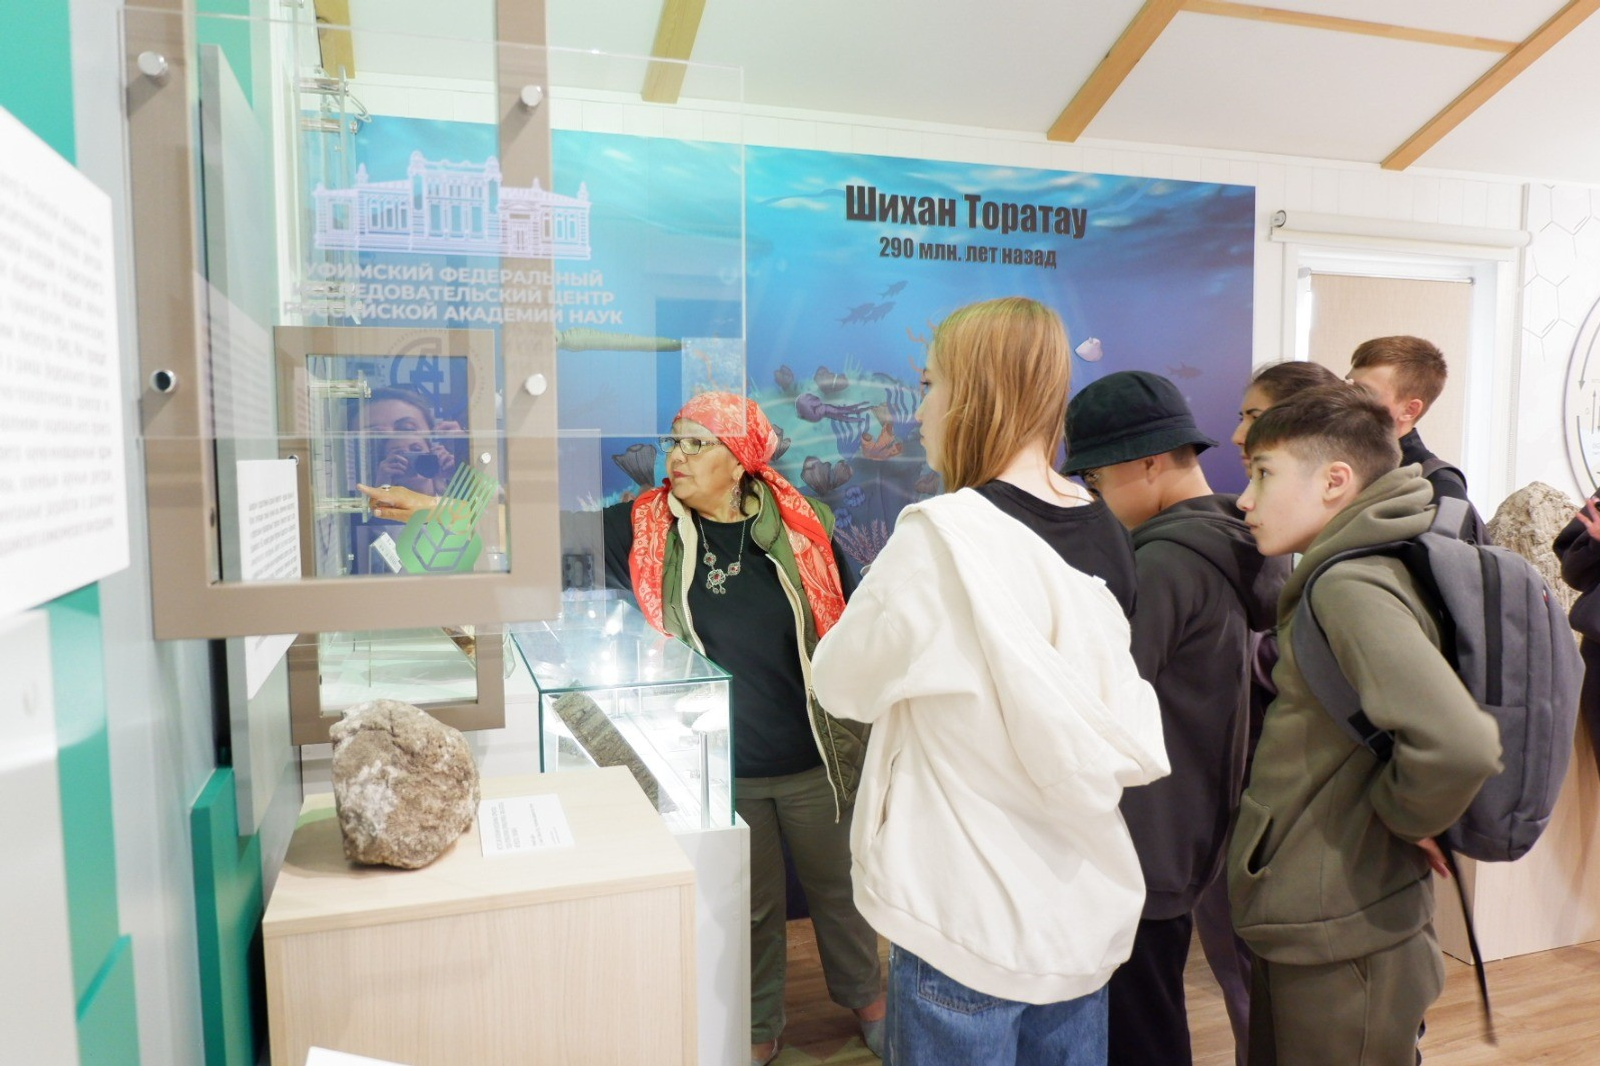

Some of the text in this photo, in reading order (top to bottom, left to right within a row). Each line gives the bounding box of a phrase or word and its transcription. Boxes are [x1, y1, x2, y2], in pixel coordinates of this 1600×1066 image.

[846, 185, 1088, 239] Шихан Торатау
[879, 236, 1057, 269] 290 млн. лет назад
[305, 262, 603, 287] УФИМСКИЙ ФЕДЕРАЛЬНЫЙ
[292, 281, 615, 306] ИСЛЕДОВАТЕЛЬСКИЙ ЦЕНТР
[444, 305, 563, 324] АКАДЕМИИ
[569, 310, 623, 325] НАУК
